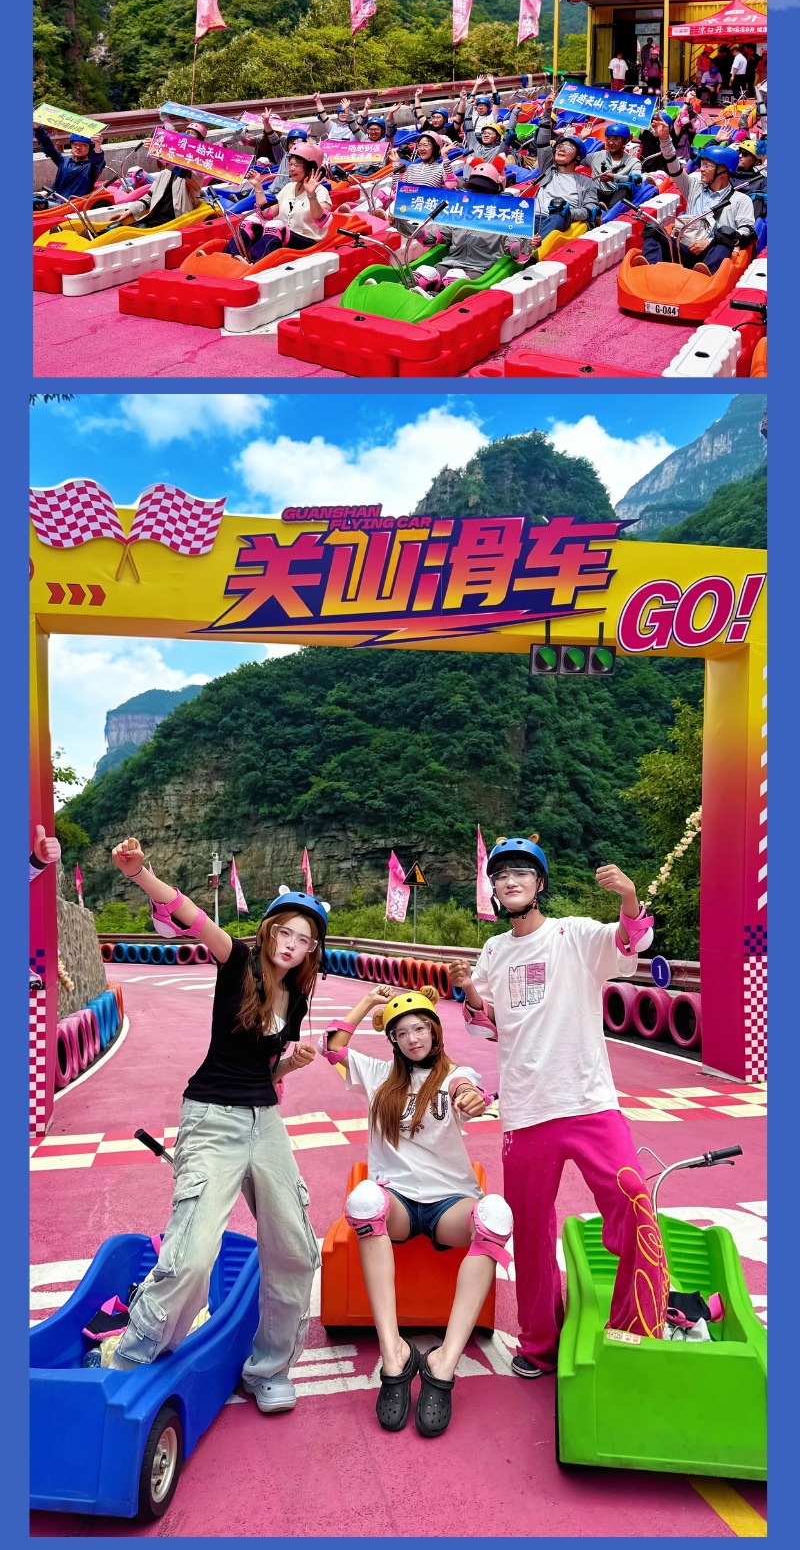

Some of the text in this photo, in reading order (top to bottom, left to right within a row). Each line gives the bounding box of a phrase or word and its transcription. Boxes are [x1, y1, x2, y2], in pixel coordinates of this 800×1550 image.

[178, 138, 225, 162] 滑一趟关山
[411, 196, 463, 216] 滑越山
[472, 205, 525, 224] 万事不难
[282, 505, 382, 521] GUANSHAN
[329, 516, 432, 530] FLYING CAR
[213, 516, 628, 628] 关山滑车
[617, 572, 766, 653] GO!
